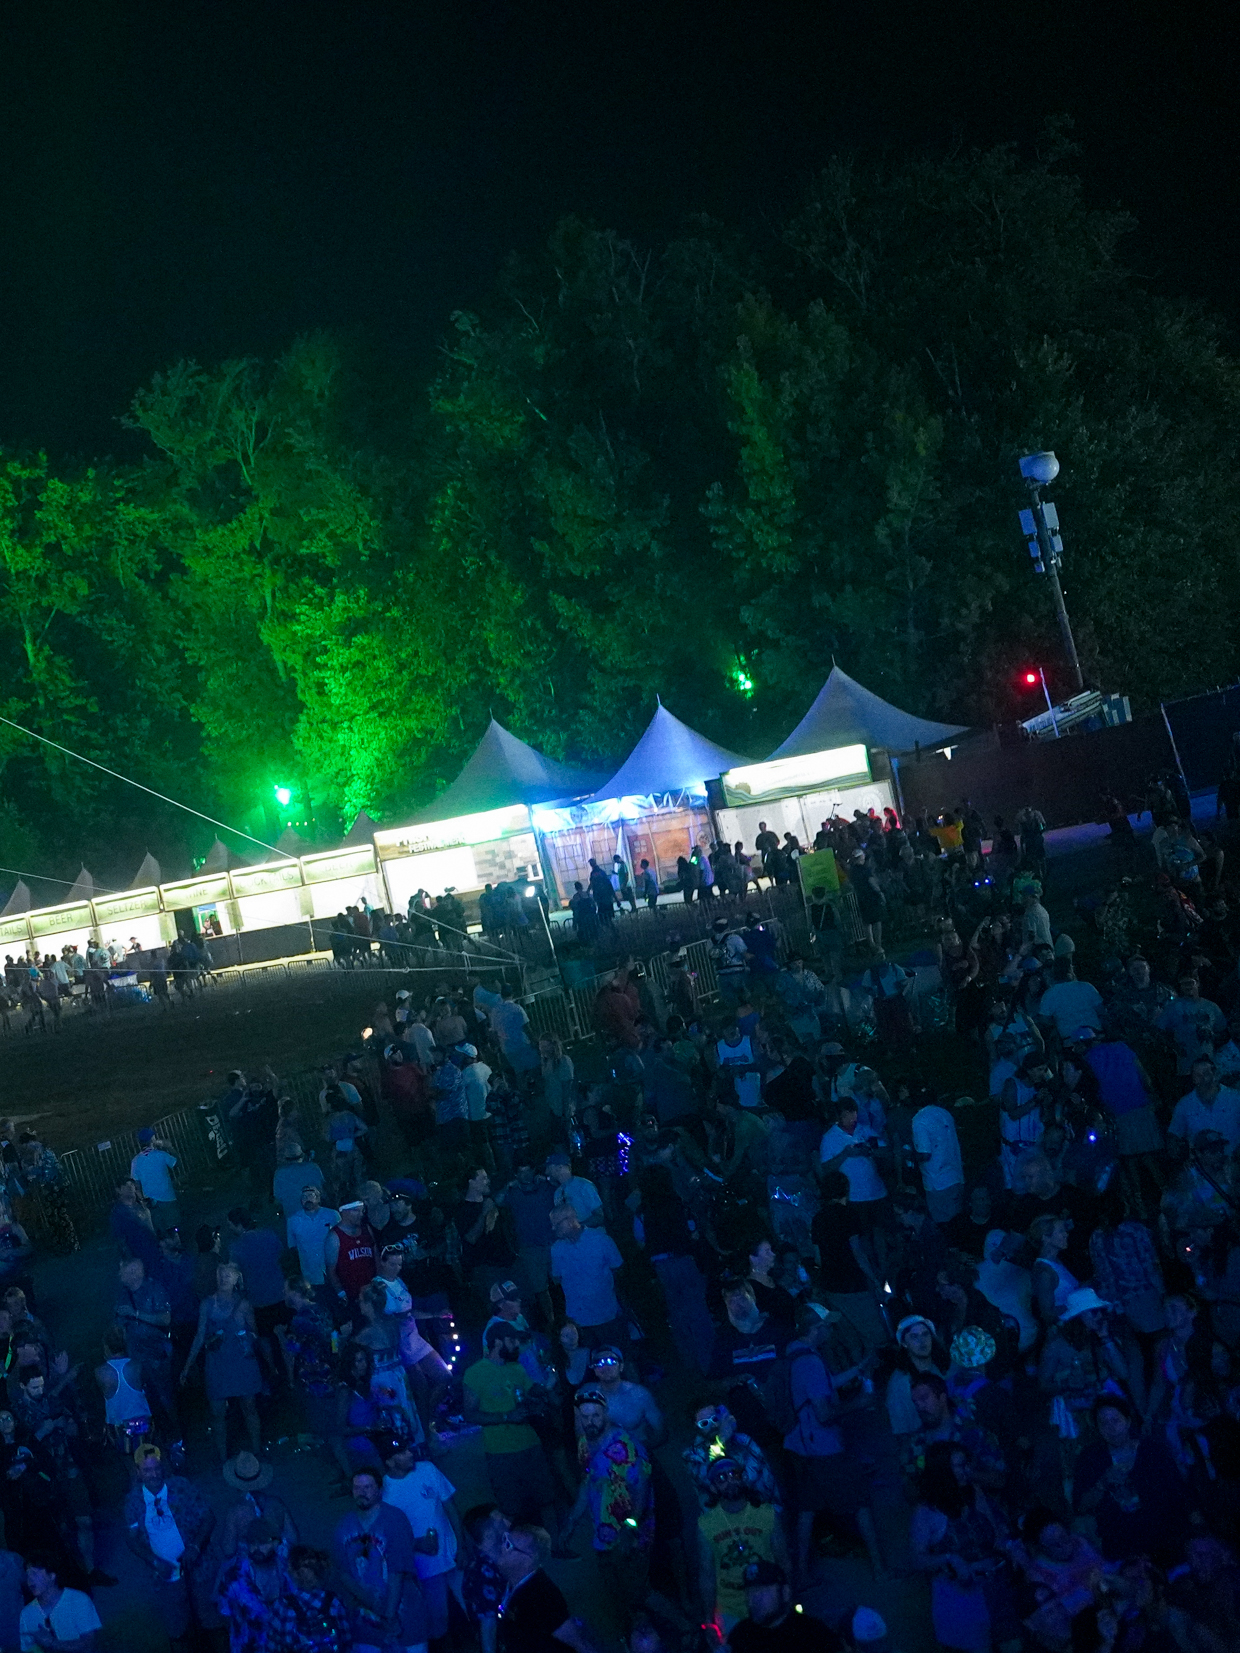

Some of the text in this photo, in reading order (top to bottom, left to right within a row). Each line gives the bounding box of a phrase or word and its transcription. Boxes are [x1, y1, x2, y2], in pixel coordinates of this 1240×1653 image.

[106, 900, 147, 915] SELTZER
[48, 912, 74, 926] BEER
[347, 1246, 374, 1261] WILSON
